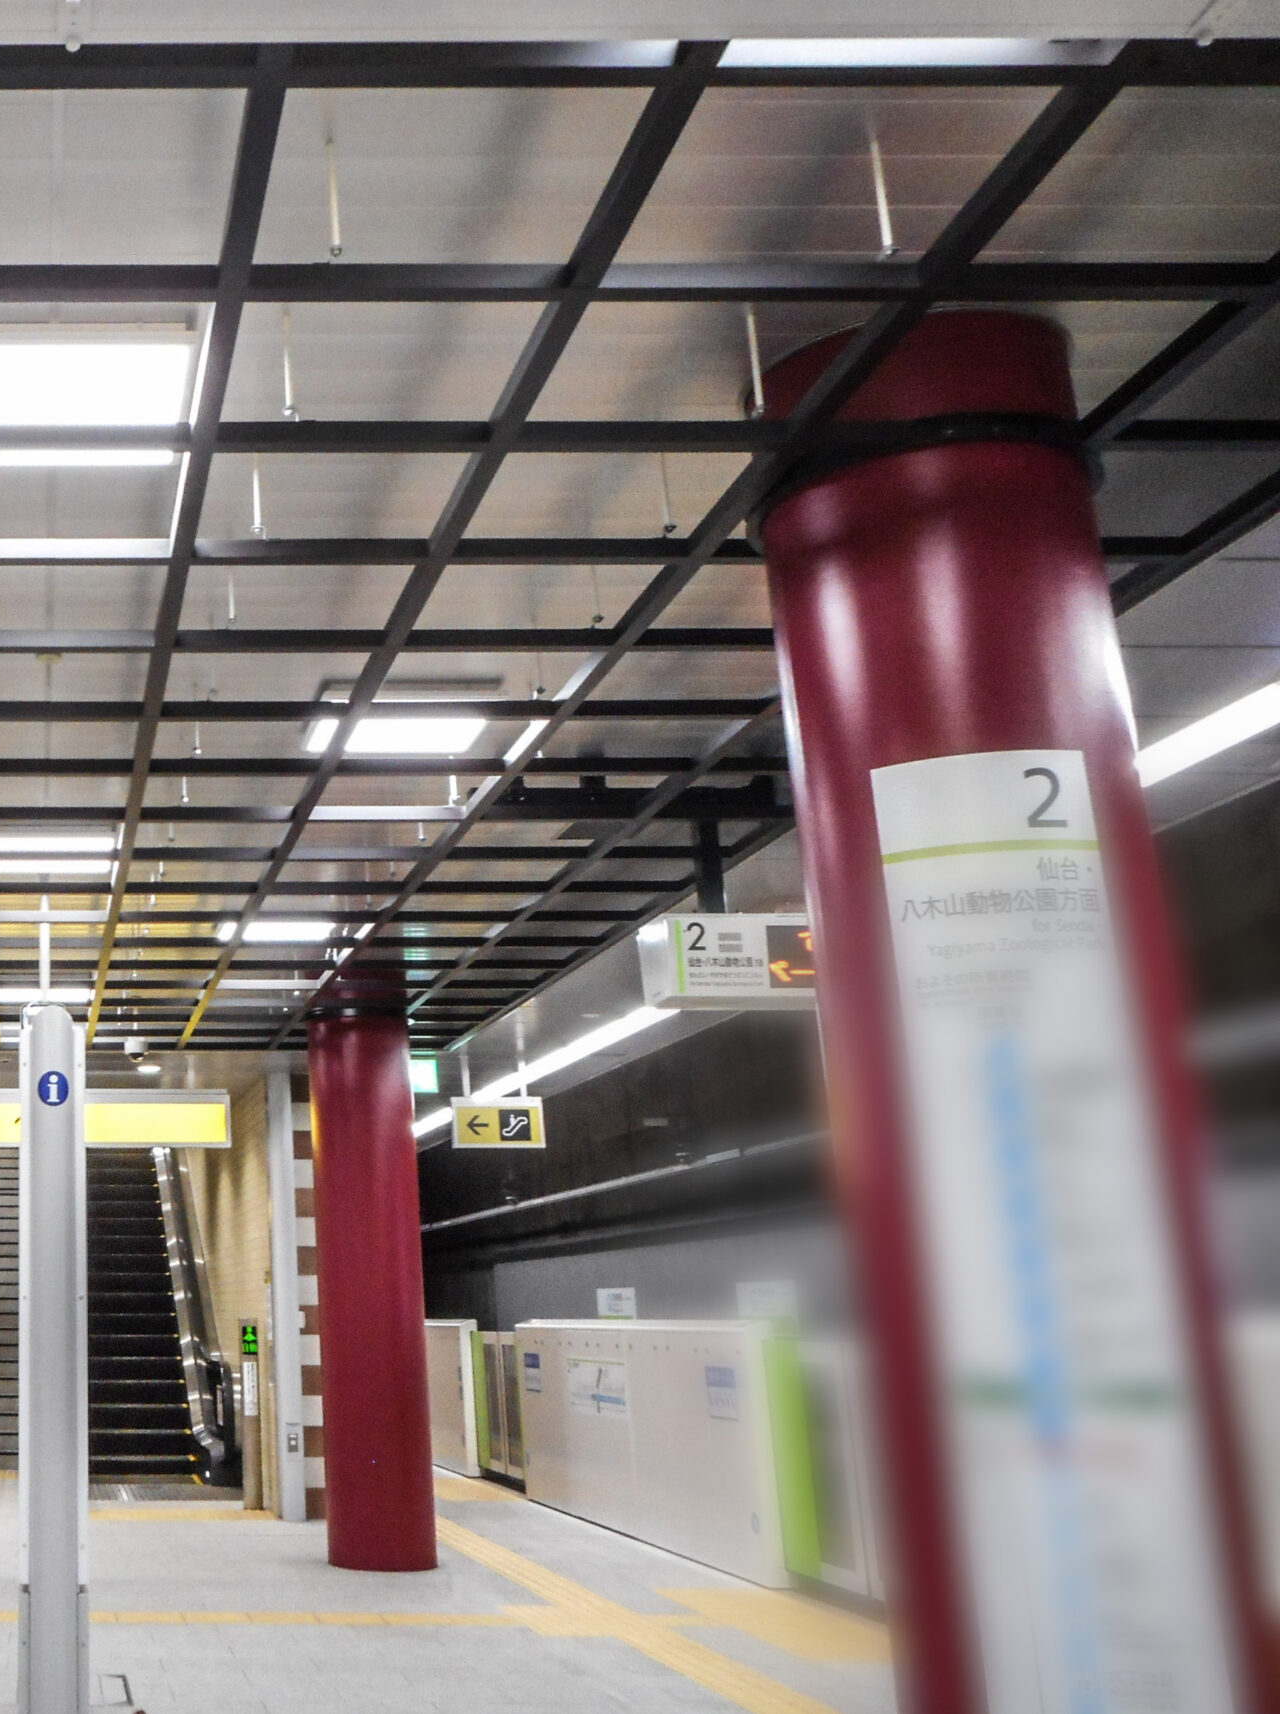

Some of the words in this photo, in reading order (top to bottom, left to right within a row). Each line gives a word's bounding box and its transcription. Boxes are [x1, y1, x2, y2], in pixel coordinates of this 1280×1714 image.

[1023, 767, 1068, 828] 2
[901, 888, 1100, 922] 八木山動物公園方面
[686, 922, 707, 951] 2
